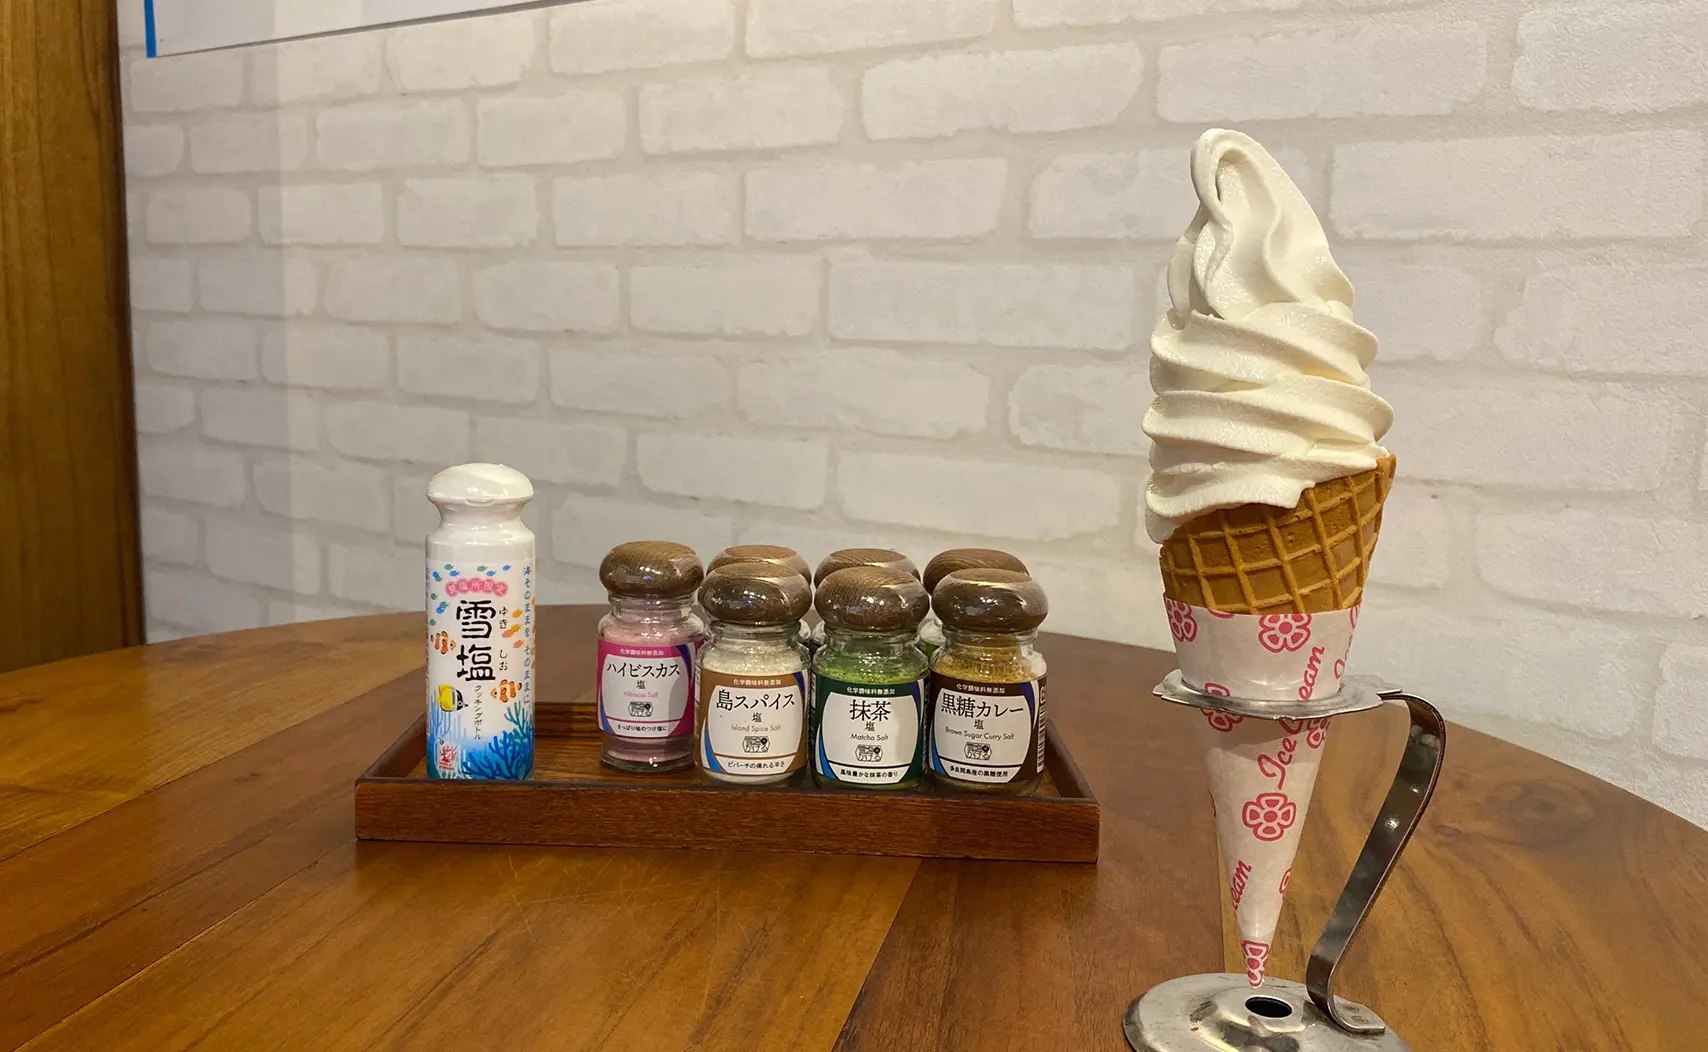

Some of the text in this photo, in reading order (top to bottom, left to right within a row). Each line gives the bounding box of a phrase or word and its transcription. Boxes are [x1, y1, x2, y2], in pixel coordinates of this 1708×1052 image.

[456, 600, 496, 681] 雪塩
[499, 606, 508, 671] ゆき しお
[620, 647, 665, 656] 化学調味料無添加
[606, 662, 681, 679] ハイビスカス
[636, 680, 646, 690] 塩
[733, 678, 782, 687] 化学調味料無添加
[846, 686, 896, 695] 化学調味料無添加
[956, 683, 1005, 694] 化学調味料無添加
[716, 689, 795, 711] 島スパイス
[941, 692, 1024, 718] 黒糖カレー
[474, 684, 483, 740] クッキングボトル
[849, 699, 892, 722] 抹茶
[752, 712, 762, 723] 塩
[731, 724, 750, 732] Island
[751, 725, 769, 734] Spice
[865, 721, 875, 732] 塩
[974, 719, 984, 730] 塩
[850, 733, 889, 741] Matcha Salt
[945, 726, 962, 736] Brown
[963, 730, 982, 740] Sugar
[984, 732, 1002, 741] Curry
[1257, 738, 1297, 790] Ice
[840, 769, 899, 779] 風味豊かな抹茶の香り
